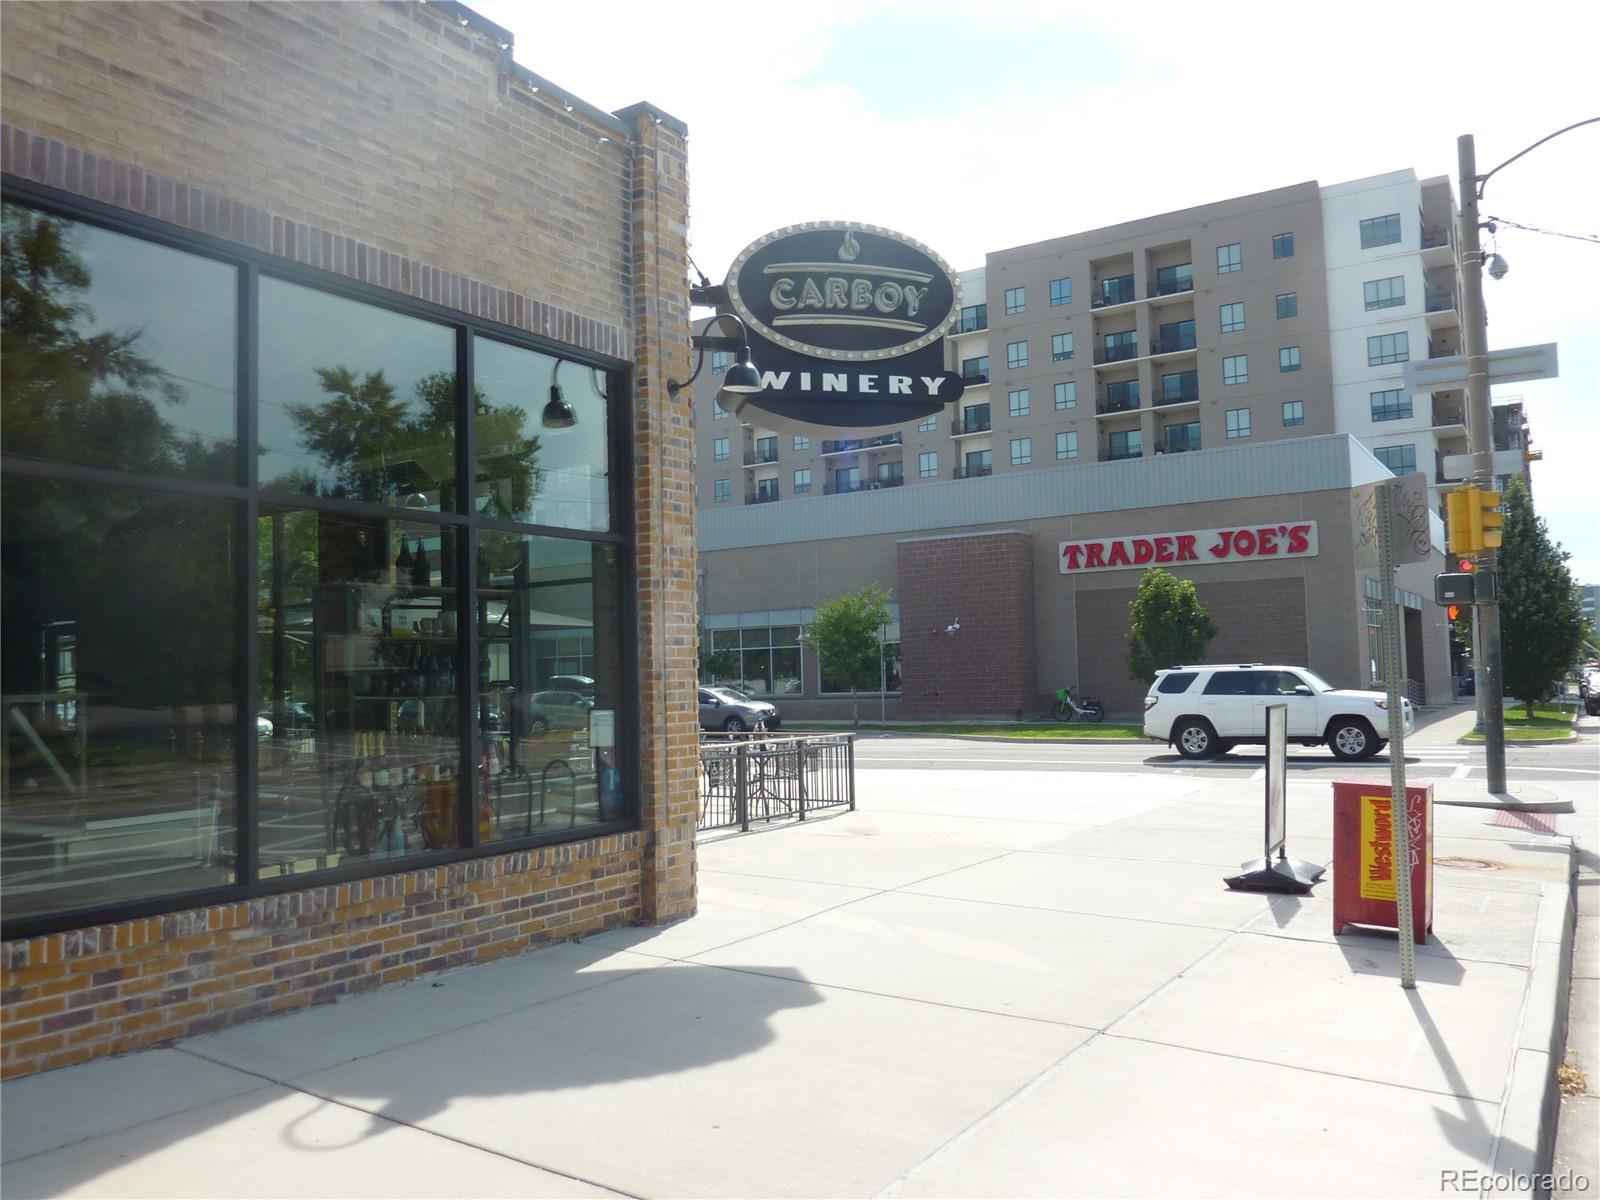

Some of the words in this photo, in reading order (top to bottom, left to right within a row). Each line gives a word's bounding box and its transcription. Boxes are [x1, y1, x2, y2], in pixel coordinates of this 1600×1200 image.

[769, 277, 929, 317] CARBOY
[761, 370, 946, 396] WINERY
[1062, 534, 1200, 570] TRADER
[1209, 524, 1313, 559] JOE'S
[1368, 799, 1393, 882] Westword
